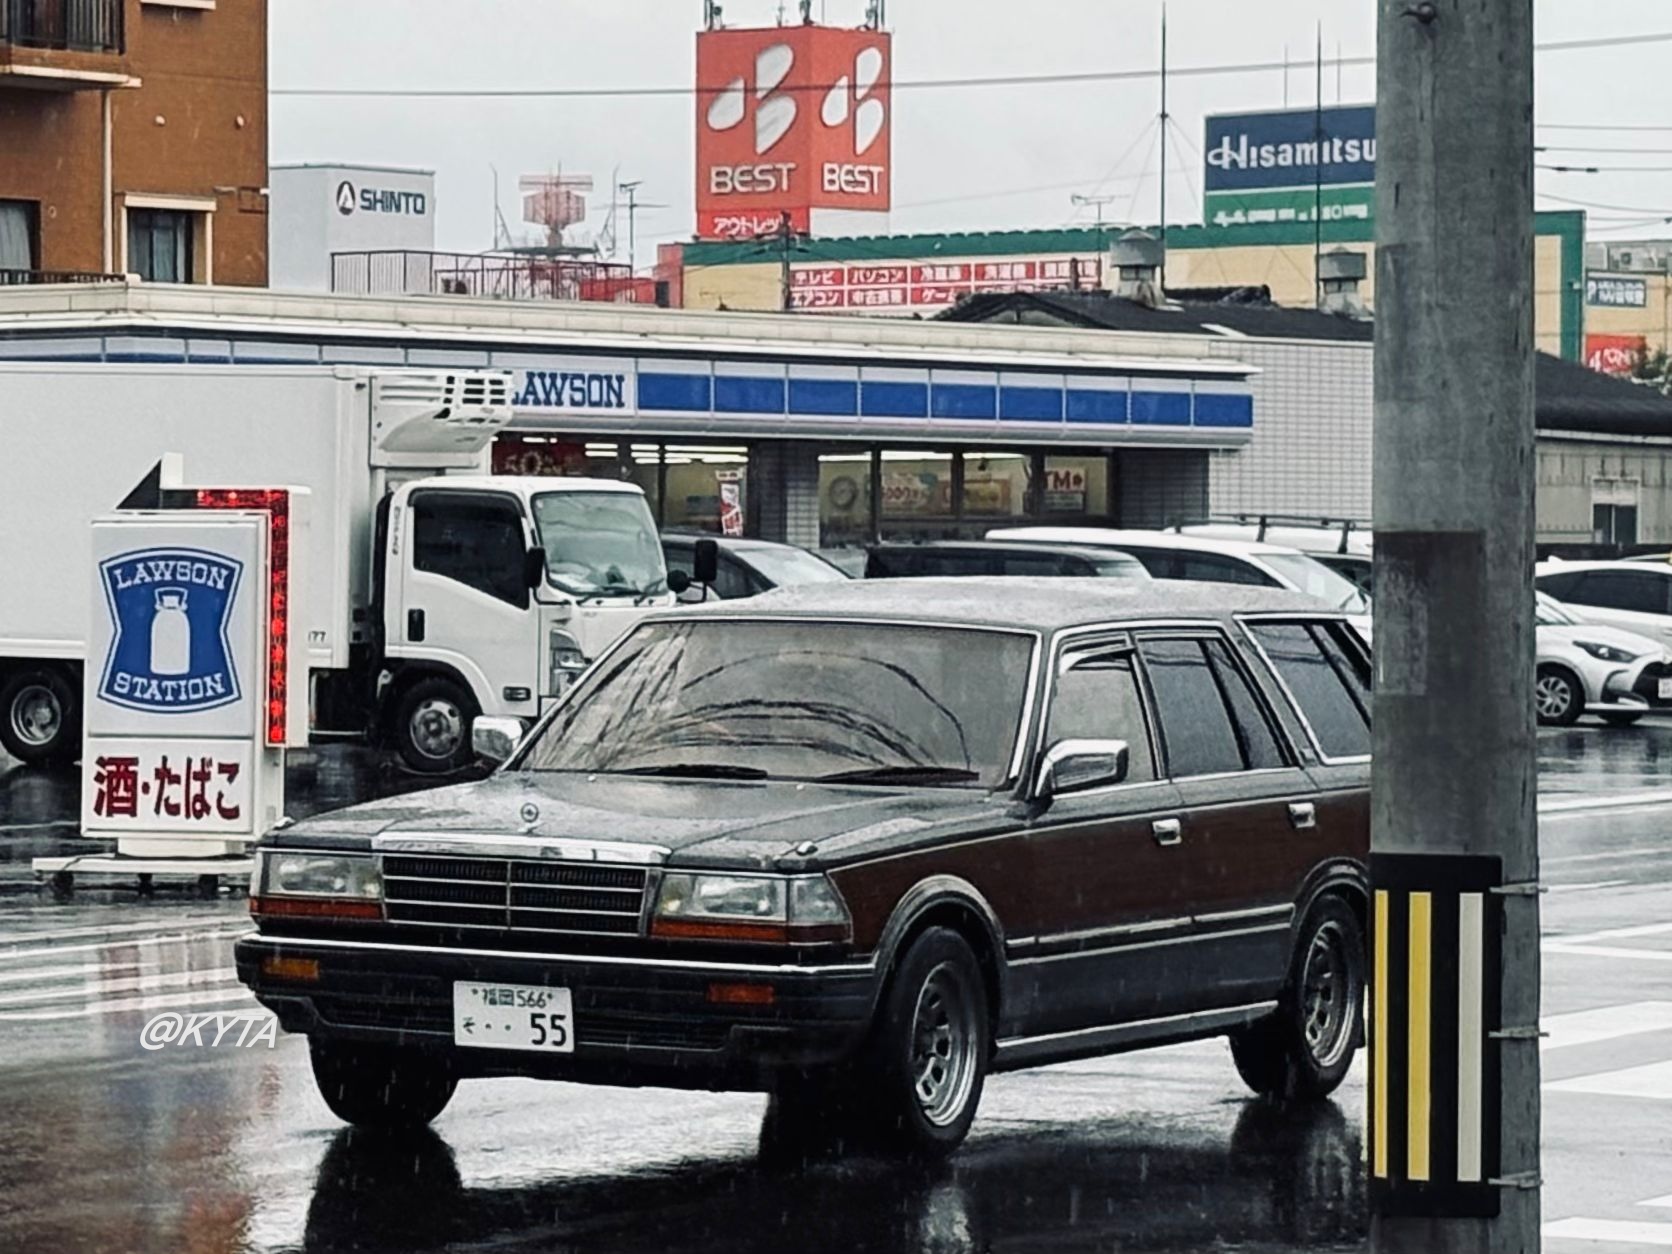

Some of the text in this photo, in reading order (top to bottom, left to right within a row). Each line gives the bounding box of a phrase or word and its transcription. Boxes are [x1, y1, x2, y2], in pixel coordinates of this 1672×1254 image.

[1207, 134, 1377, 170] Hisamitsu
[710, 162, 796, 194] BEST
[822, 162, 884, 194] BEST
[360, 188, 425, 215] SHINTO
[795, 270, 834, 285] テレビ
[852, 268, 903, 284] パソコン
[792, 289, 840, 306] エアコン
[113, 560, 229, 590] LAWSON
[113, 671, 227, 701] STATION
[93, 754, 240, 820] 酒・たばこ
